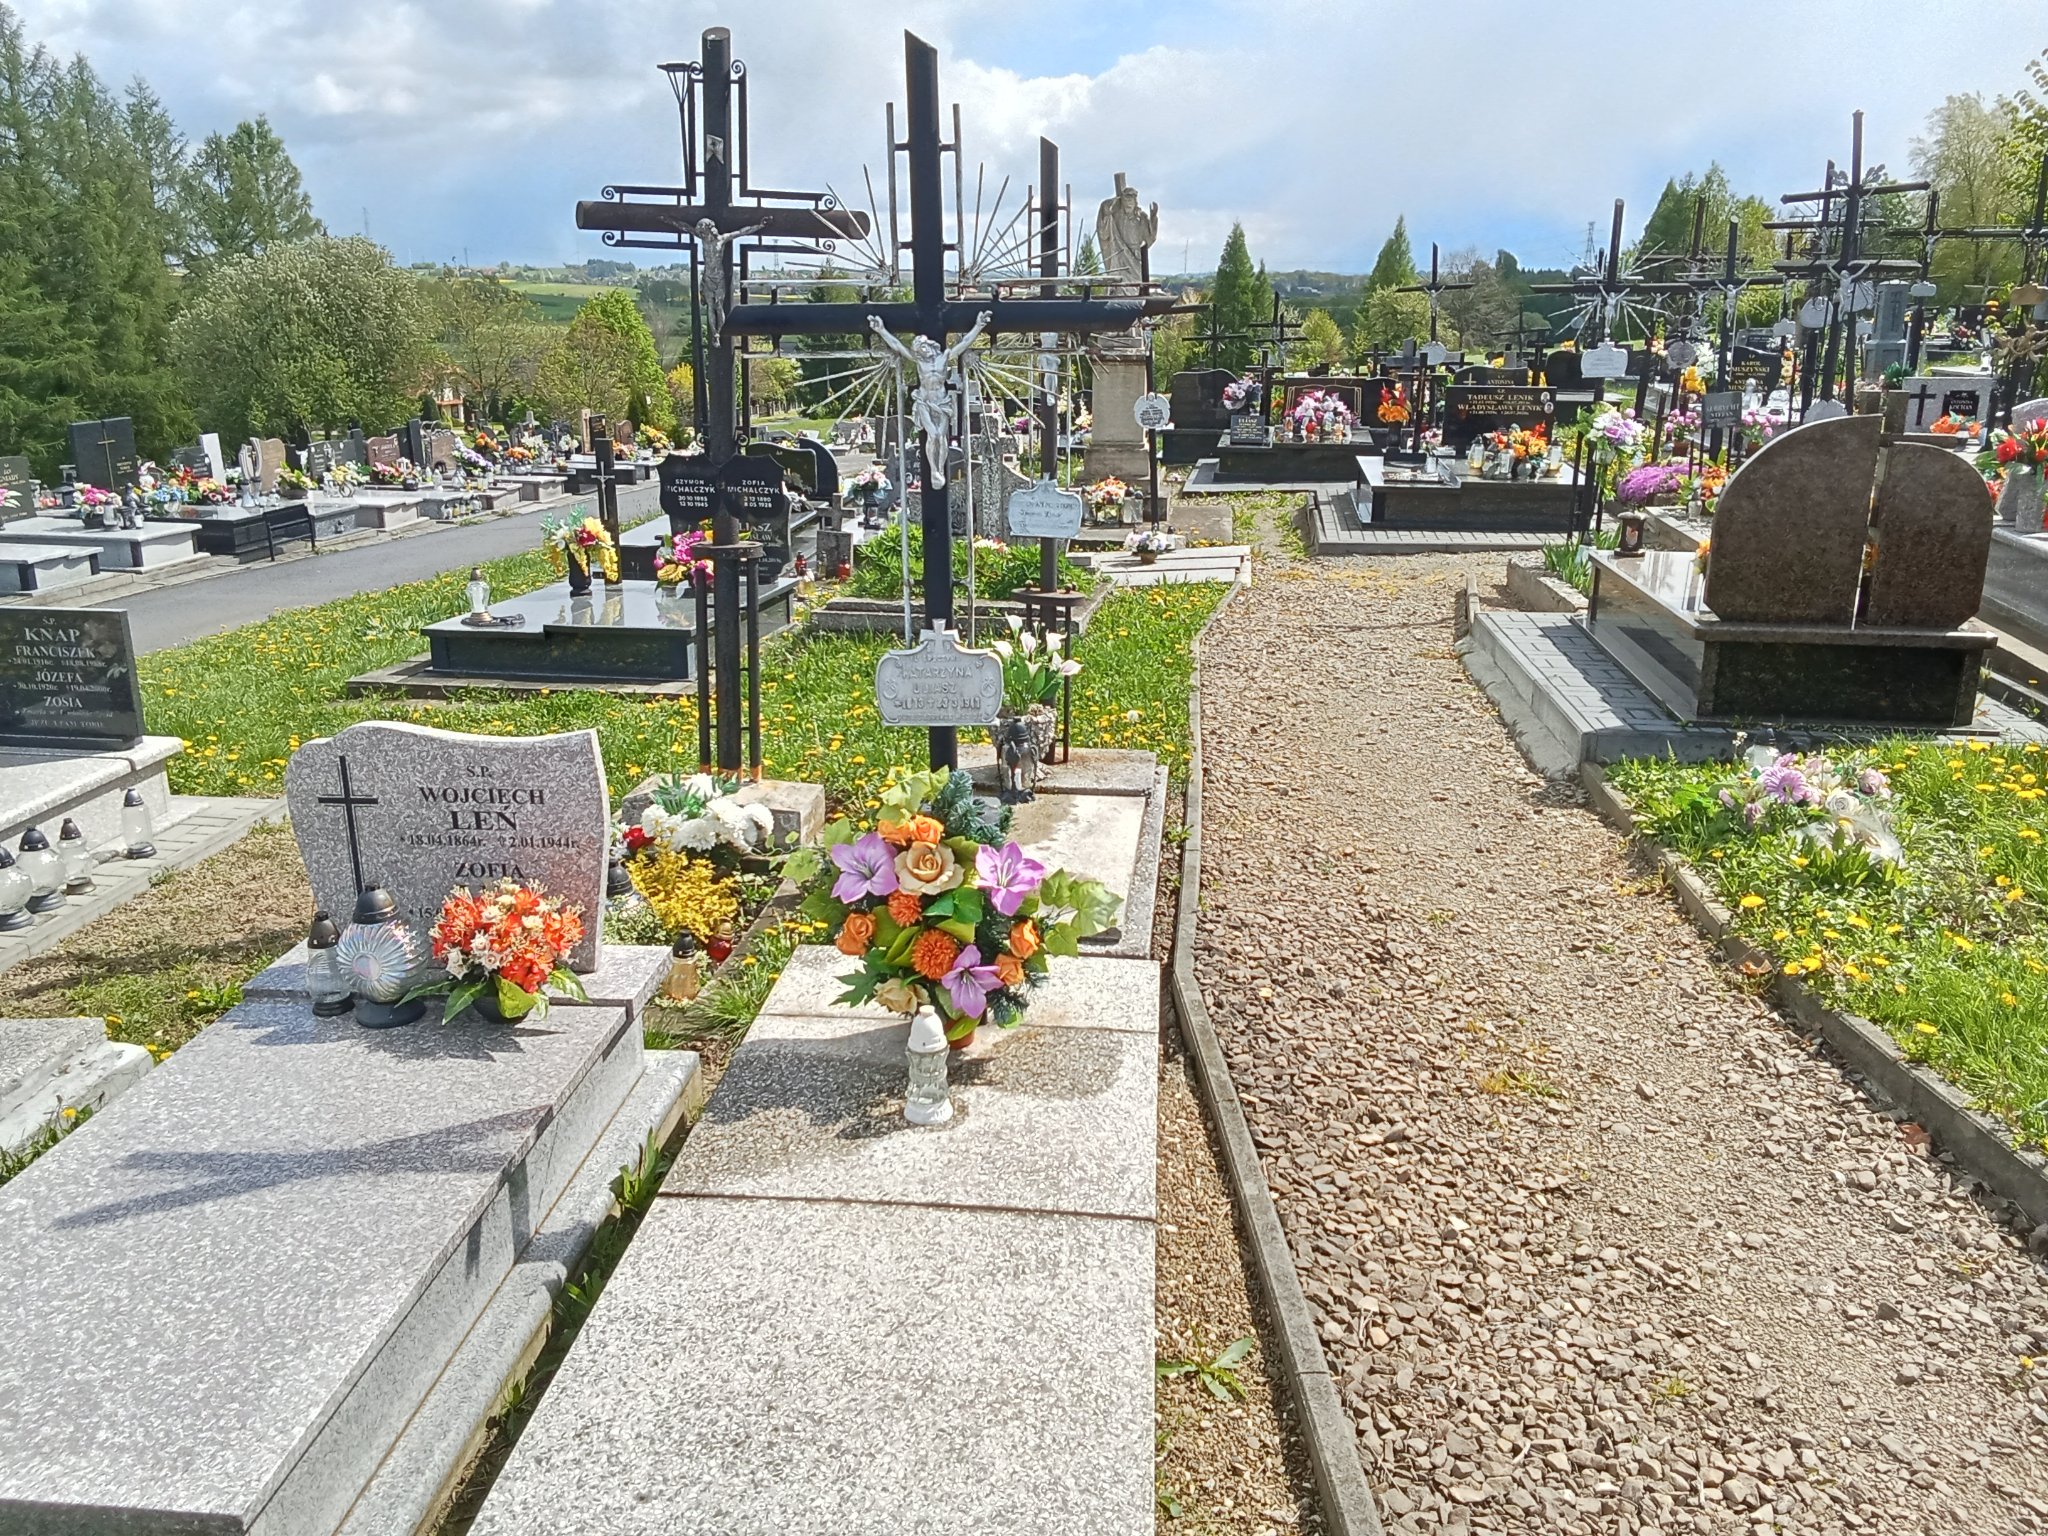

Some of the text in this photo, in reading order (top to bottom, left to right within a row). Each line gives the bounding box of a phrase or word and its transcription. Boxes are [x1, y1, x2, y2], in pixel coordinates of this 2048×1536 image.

[742, 479, 766, 487] ZOFIA
[24, 627, 80, 642] KNAP
[15, 645, 96, 658] FRANCISZEK
[36, 668, 83, 683] JÓZEFA
[902, 666, 973, 679] KATARZYNA
[43, 696, 82, 708] ZOSIA
[419, 786, 545, 805] WOJCIECH
[449, 805, 518, 831] LEŃ
[455, 861, 525, 879] ZOFIA
